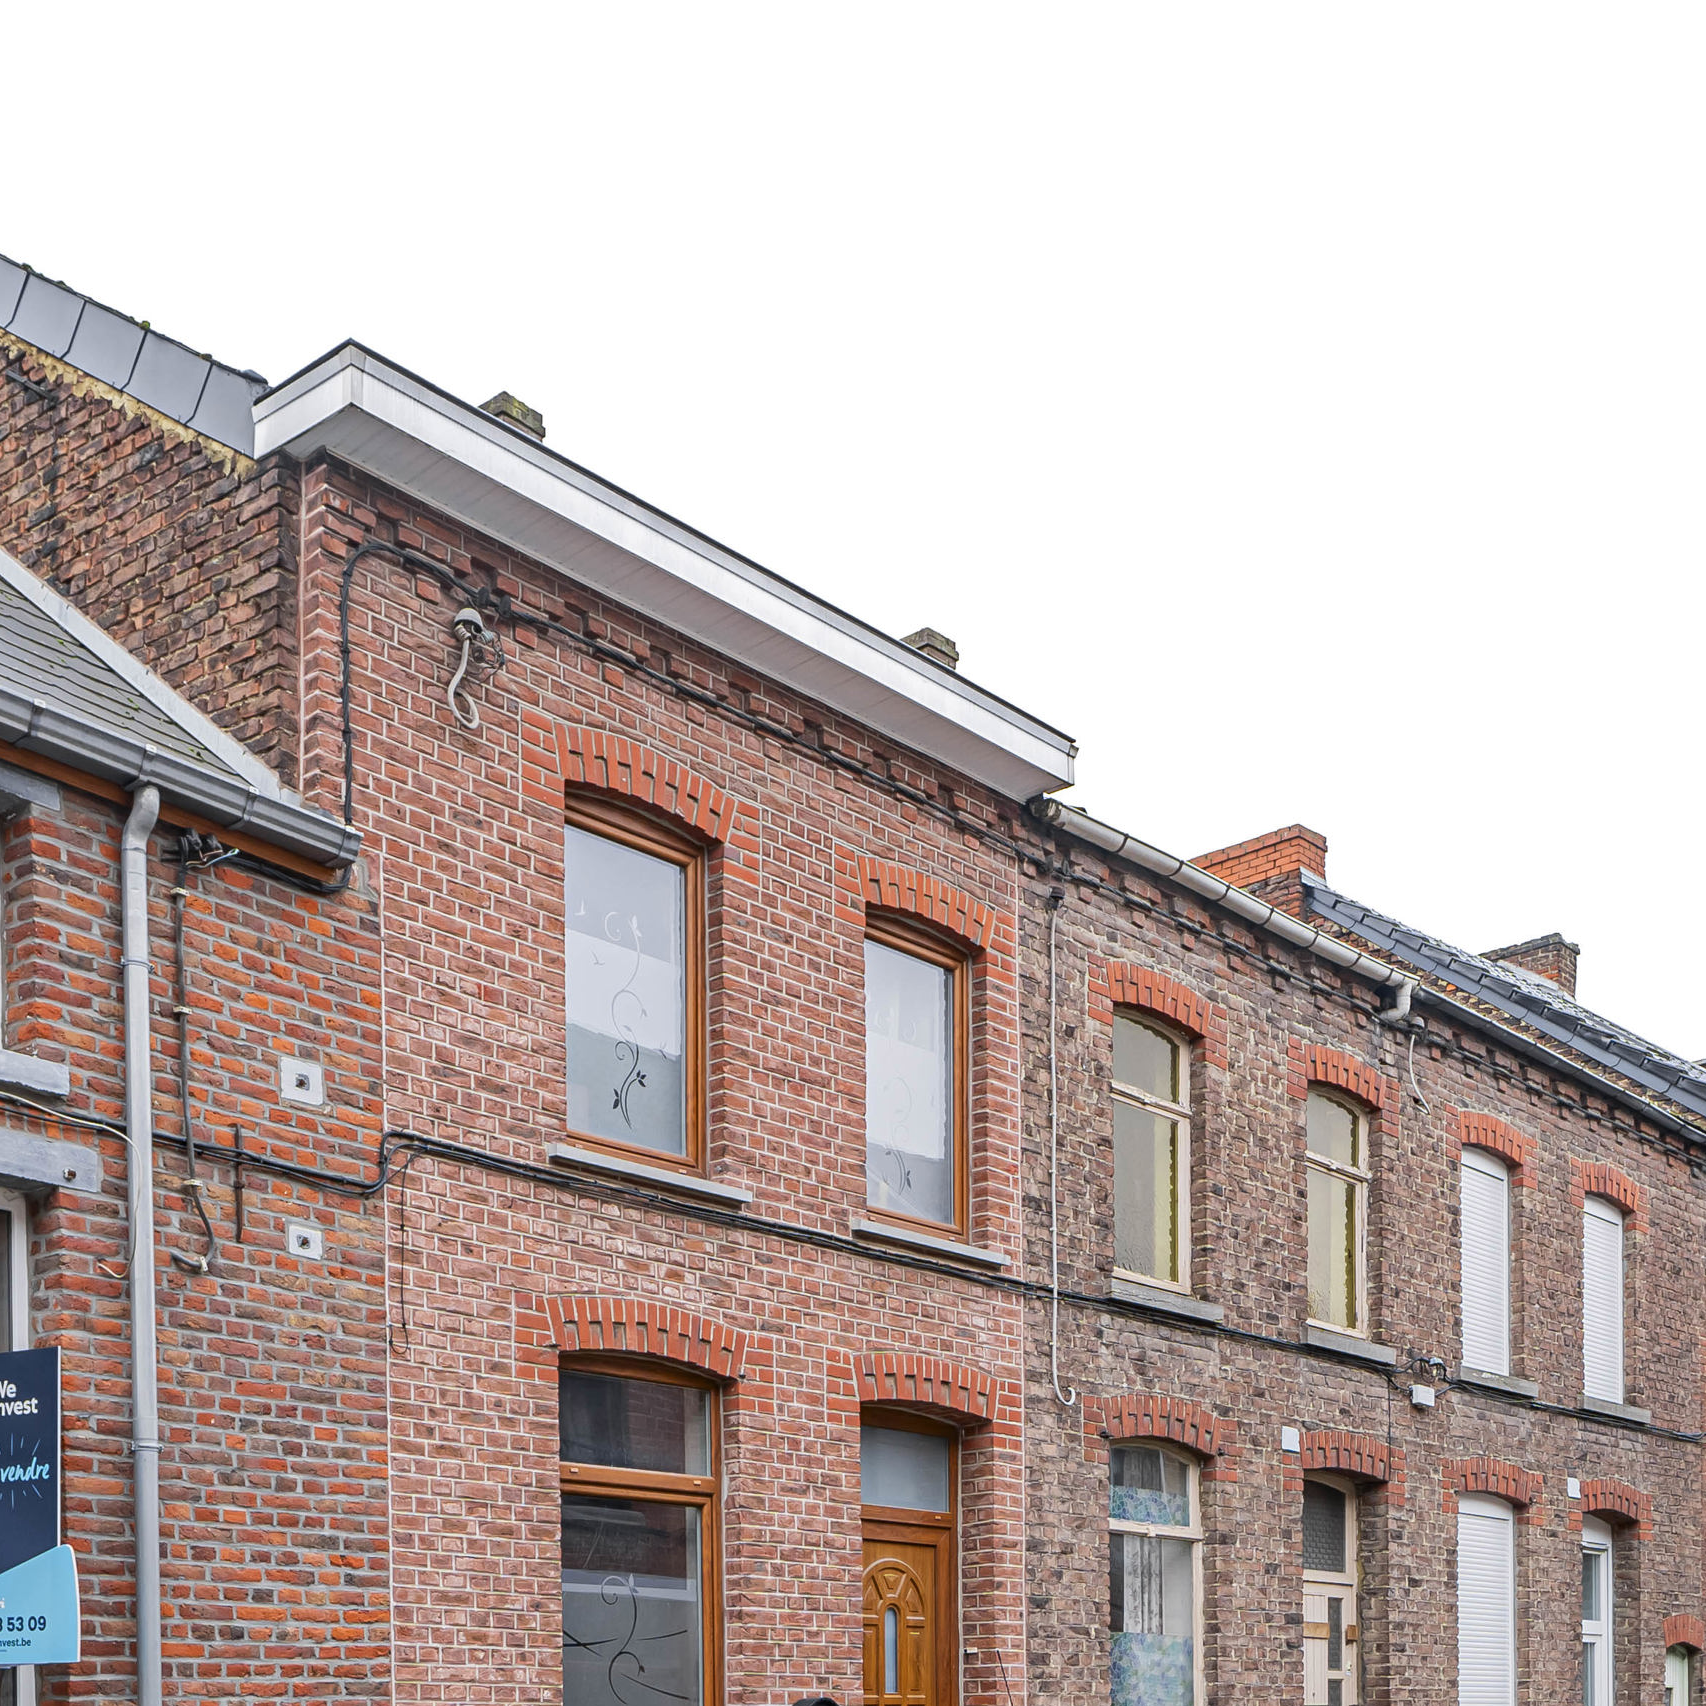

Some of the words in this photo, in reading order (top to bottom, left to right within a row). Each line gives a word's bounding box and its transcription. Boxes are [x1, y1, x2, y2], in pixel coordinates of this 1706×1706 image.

[0, 1456, 50, 1483] vendre
[6, 1616, 24, 1632] 53
[28, 1615, 47, 1631] 09
